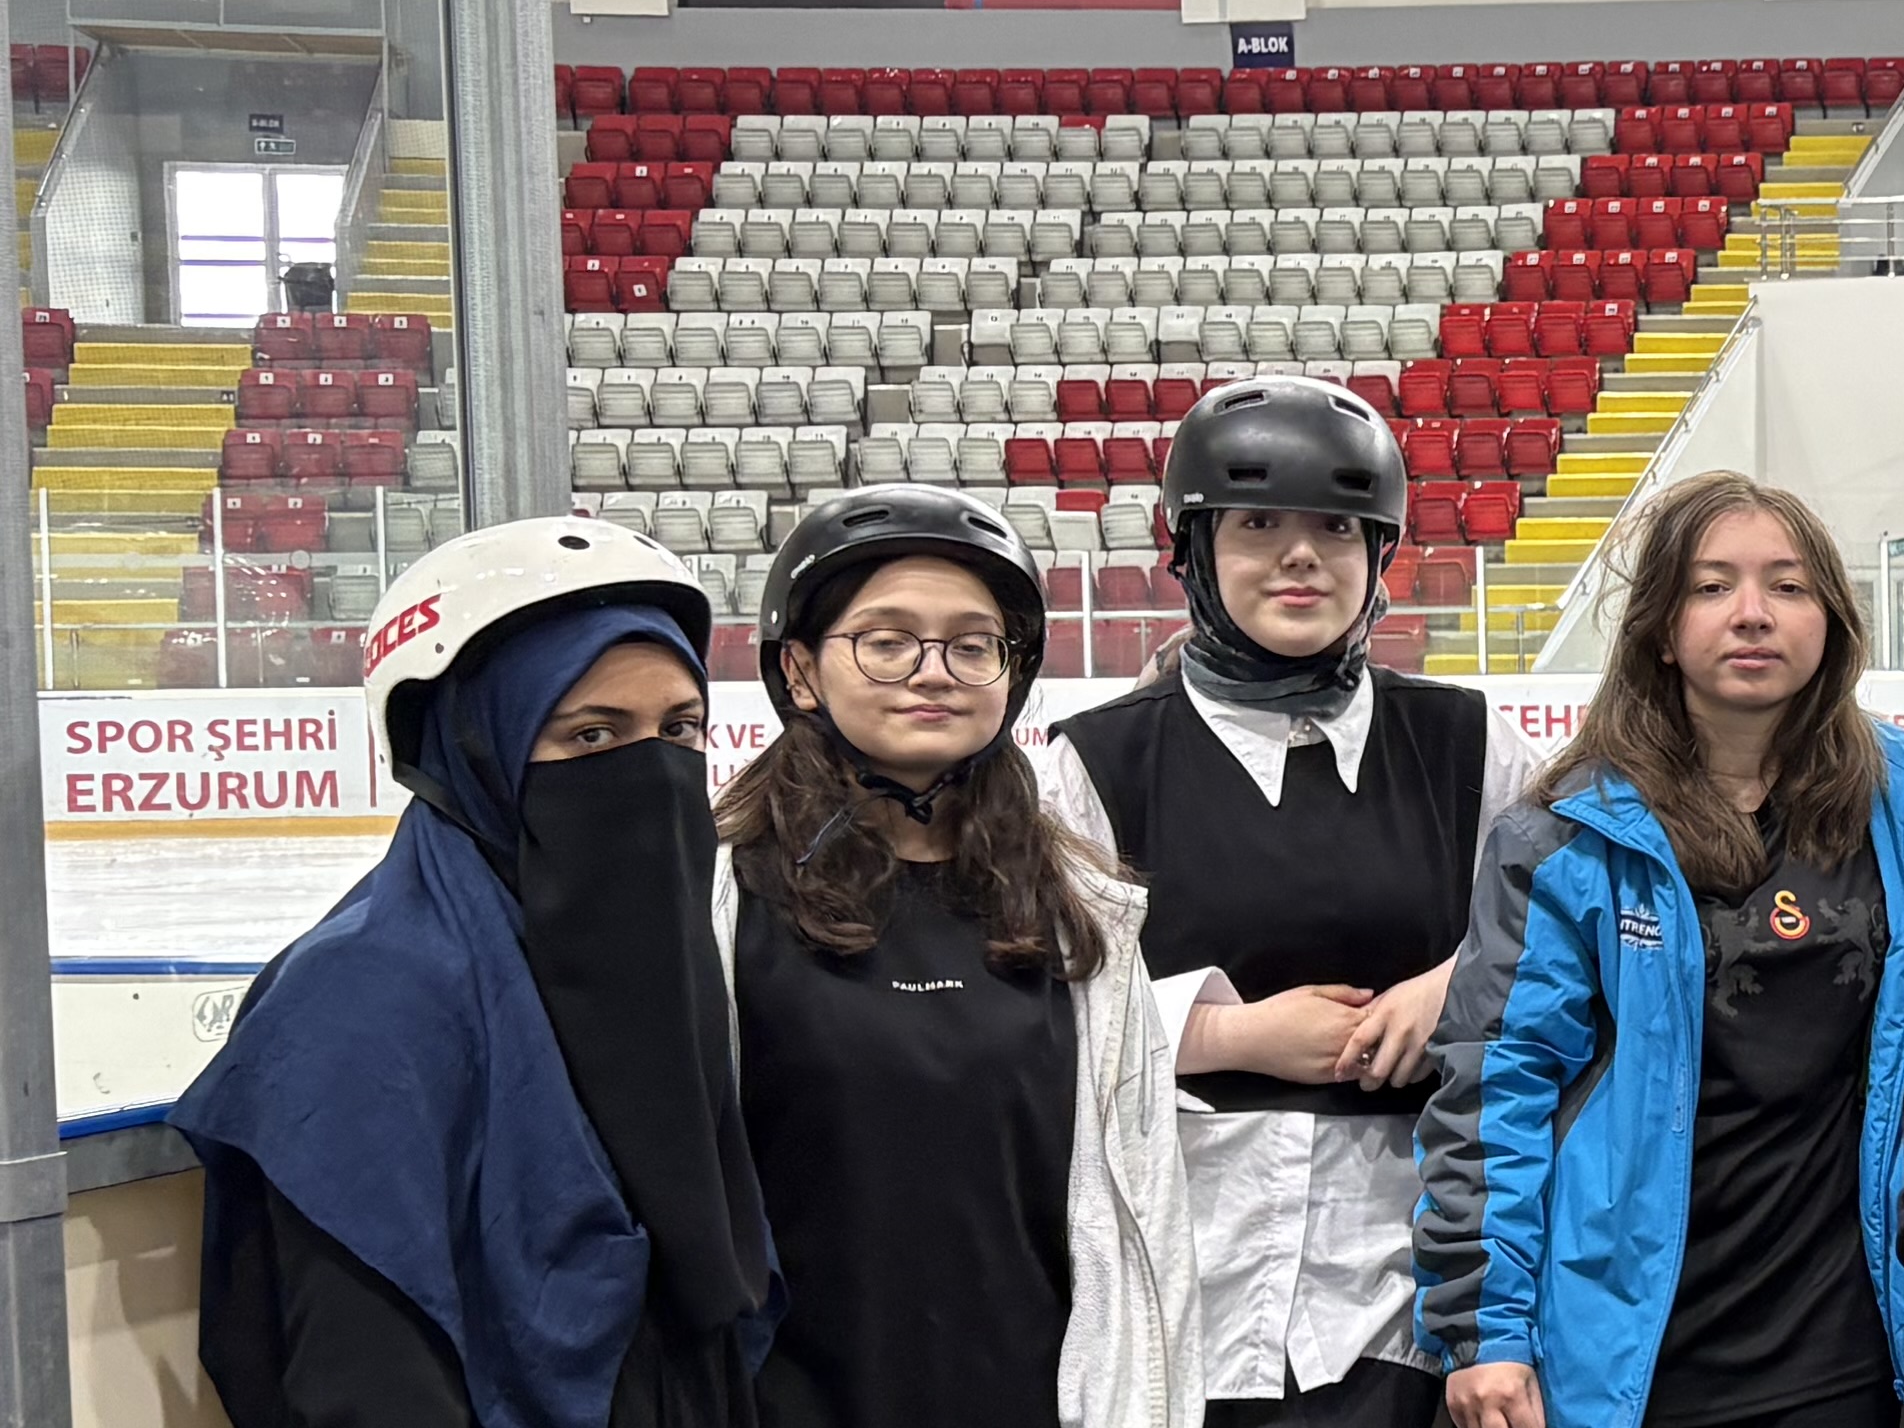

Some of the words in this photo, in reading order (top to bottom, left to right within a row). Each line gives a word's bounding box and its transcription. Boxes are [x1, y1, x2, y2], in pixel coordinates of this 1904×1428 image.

[1237, 36, 1289, 54] A-BLOK
[66, 719, 194, 754] SPOR
[206, 709, 338, 762] ŞEHRİ
[727, 724, 765, 749] VE
[66, 770, 339, 813] ERZURUM
